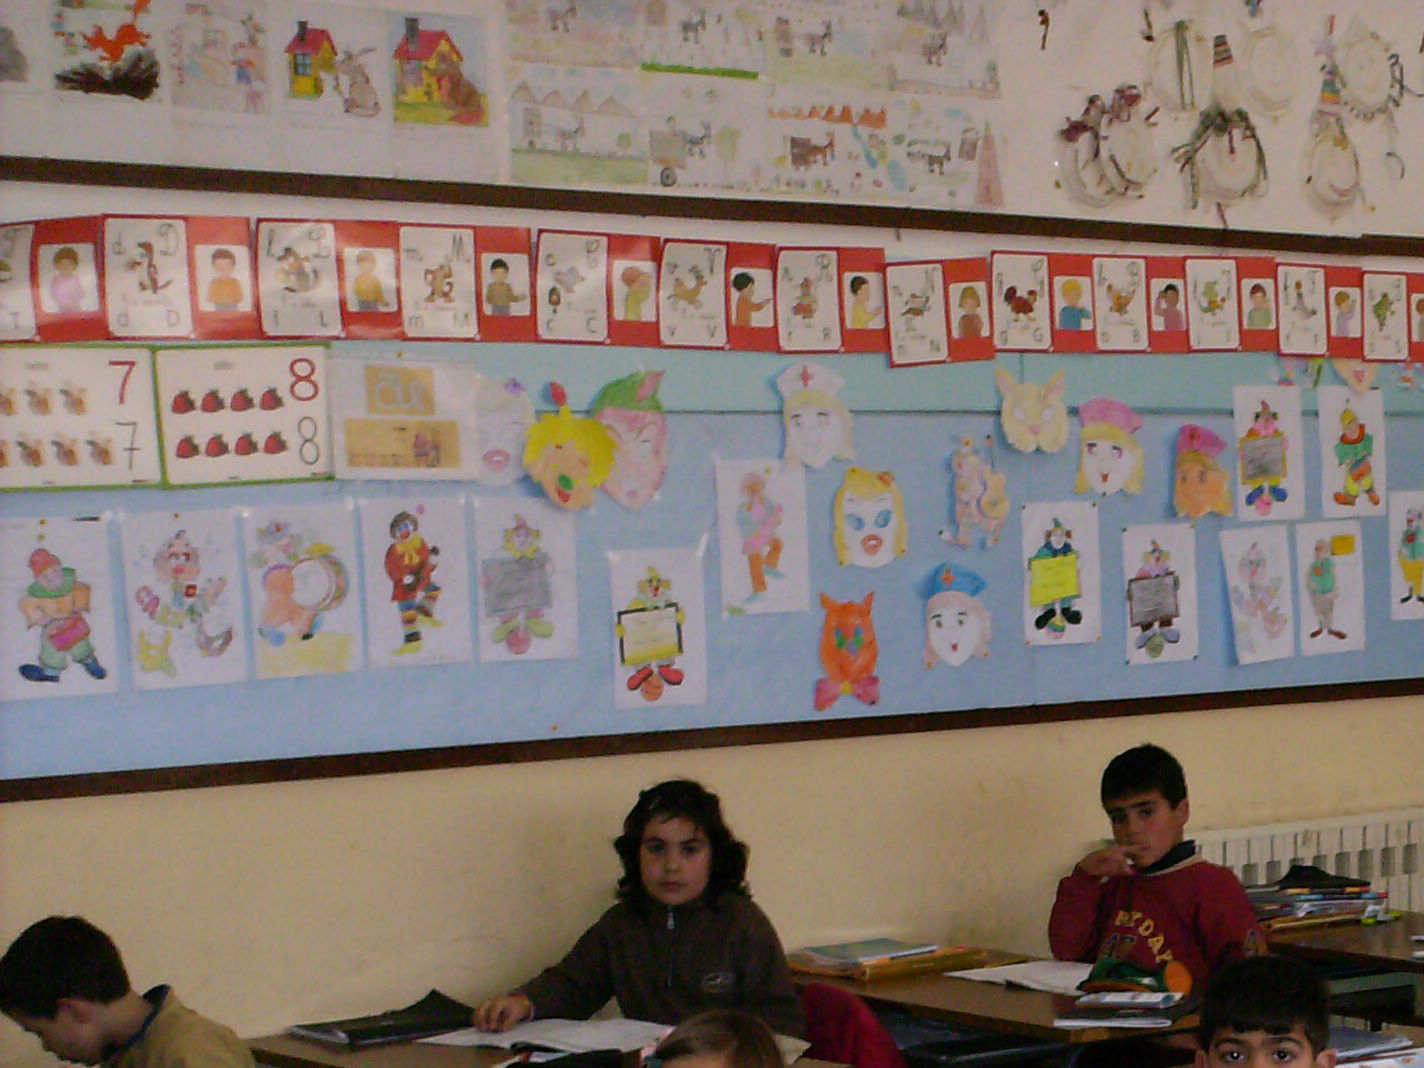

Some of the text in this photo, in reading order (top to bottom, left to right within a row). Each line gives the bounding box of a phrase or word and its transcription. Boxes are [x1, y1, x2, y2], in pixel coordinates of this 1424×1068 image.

[109, 360, 137, 405] 7
[289, 358, 319, 402] 8
[115, 421, 141, 471] 7
[298, 416, 320, 465] 8
